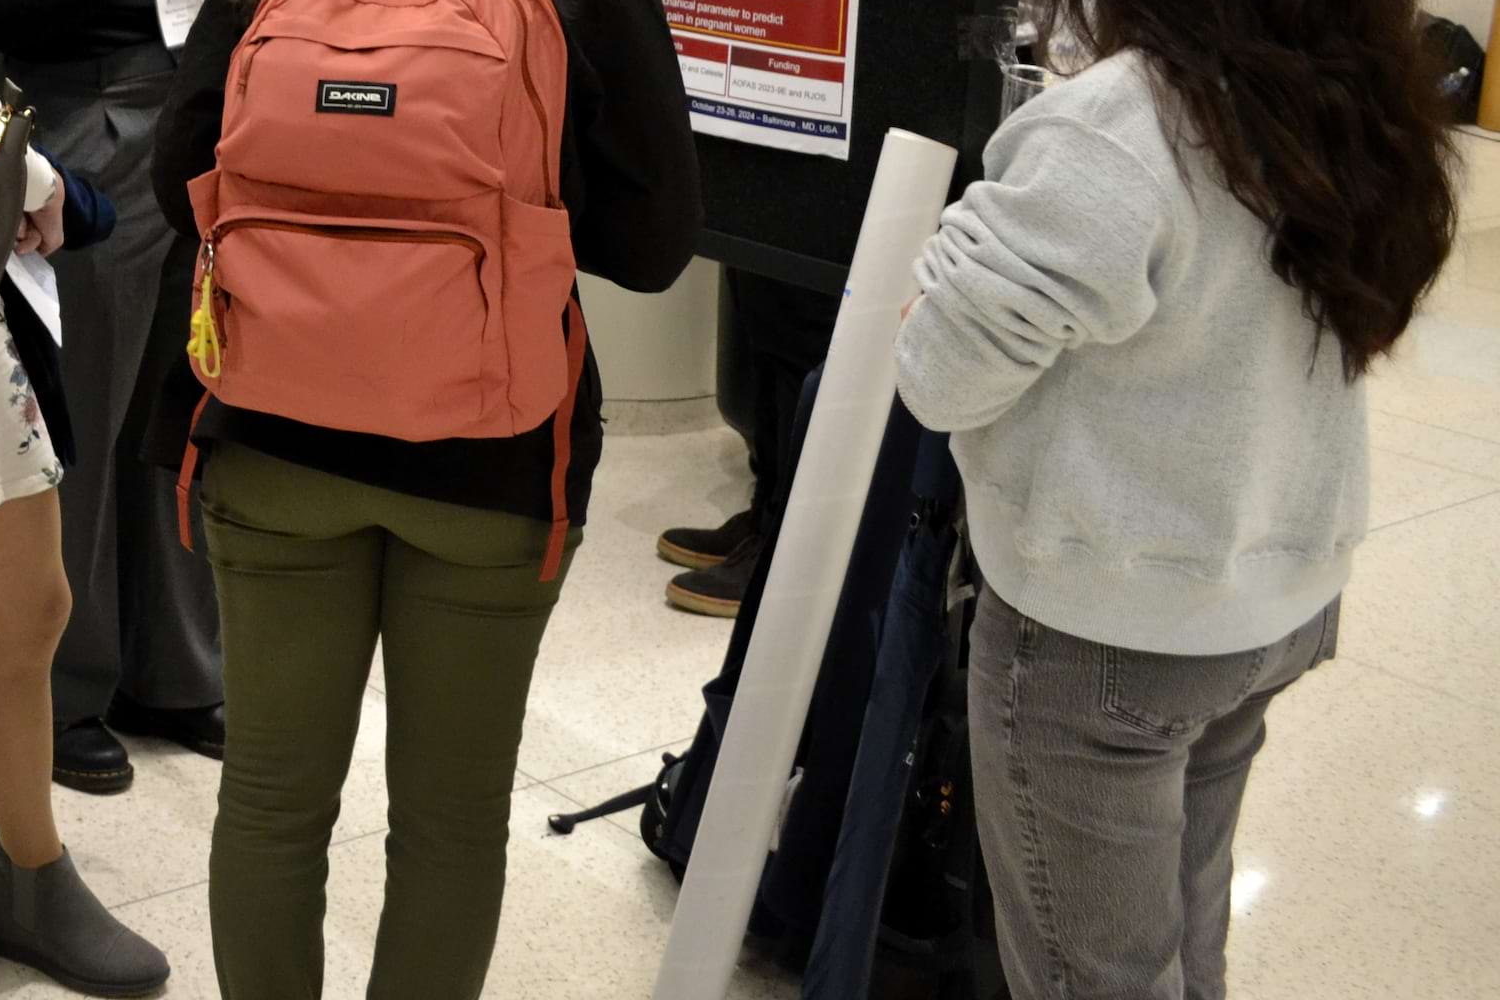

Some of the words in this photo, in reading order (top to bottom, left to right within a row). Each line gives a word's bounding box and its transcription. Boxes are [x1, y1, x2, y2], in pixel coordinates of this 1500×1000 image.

[697, 1, 739, 18] parameter
[742, 9, 751, 20] to
[753, 10, 784, 25] predict
[667, 11, 684, 23] pain
[686, 14, 693, 24] in
[695, 15, 732, 31] pregnant
[734, 24, 766, 37] women
[769, 58, 800, 73] Funding
[329, 91, 381, 102] DAKINE
[789, 89, 801, 98] and
[692, 100, 715, 112] October
[738, 108, 755, 120] 2024
[819, 125, 838, 134] USA
